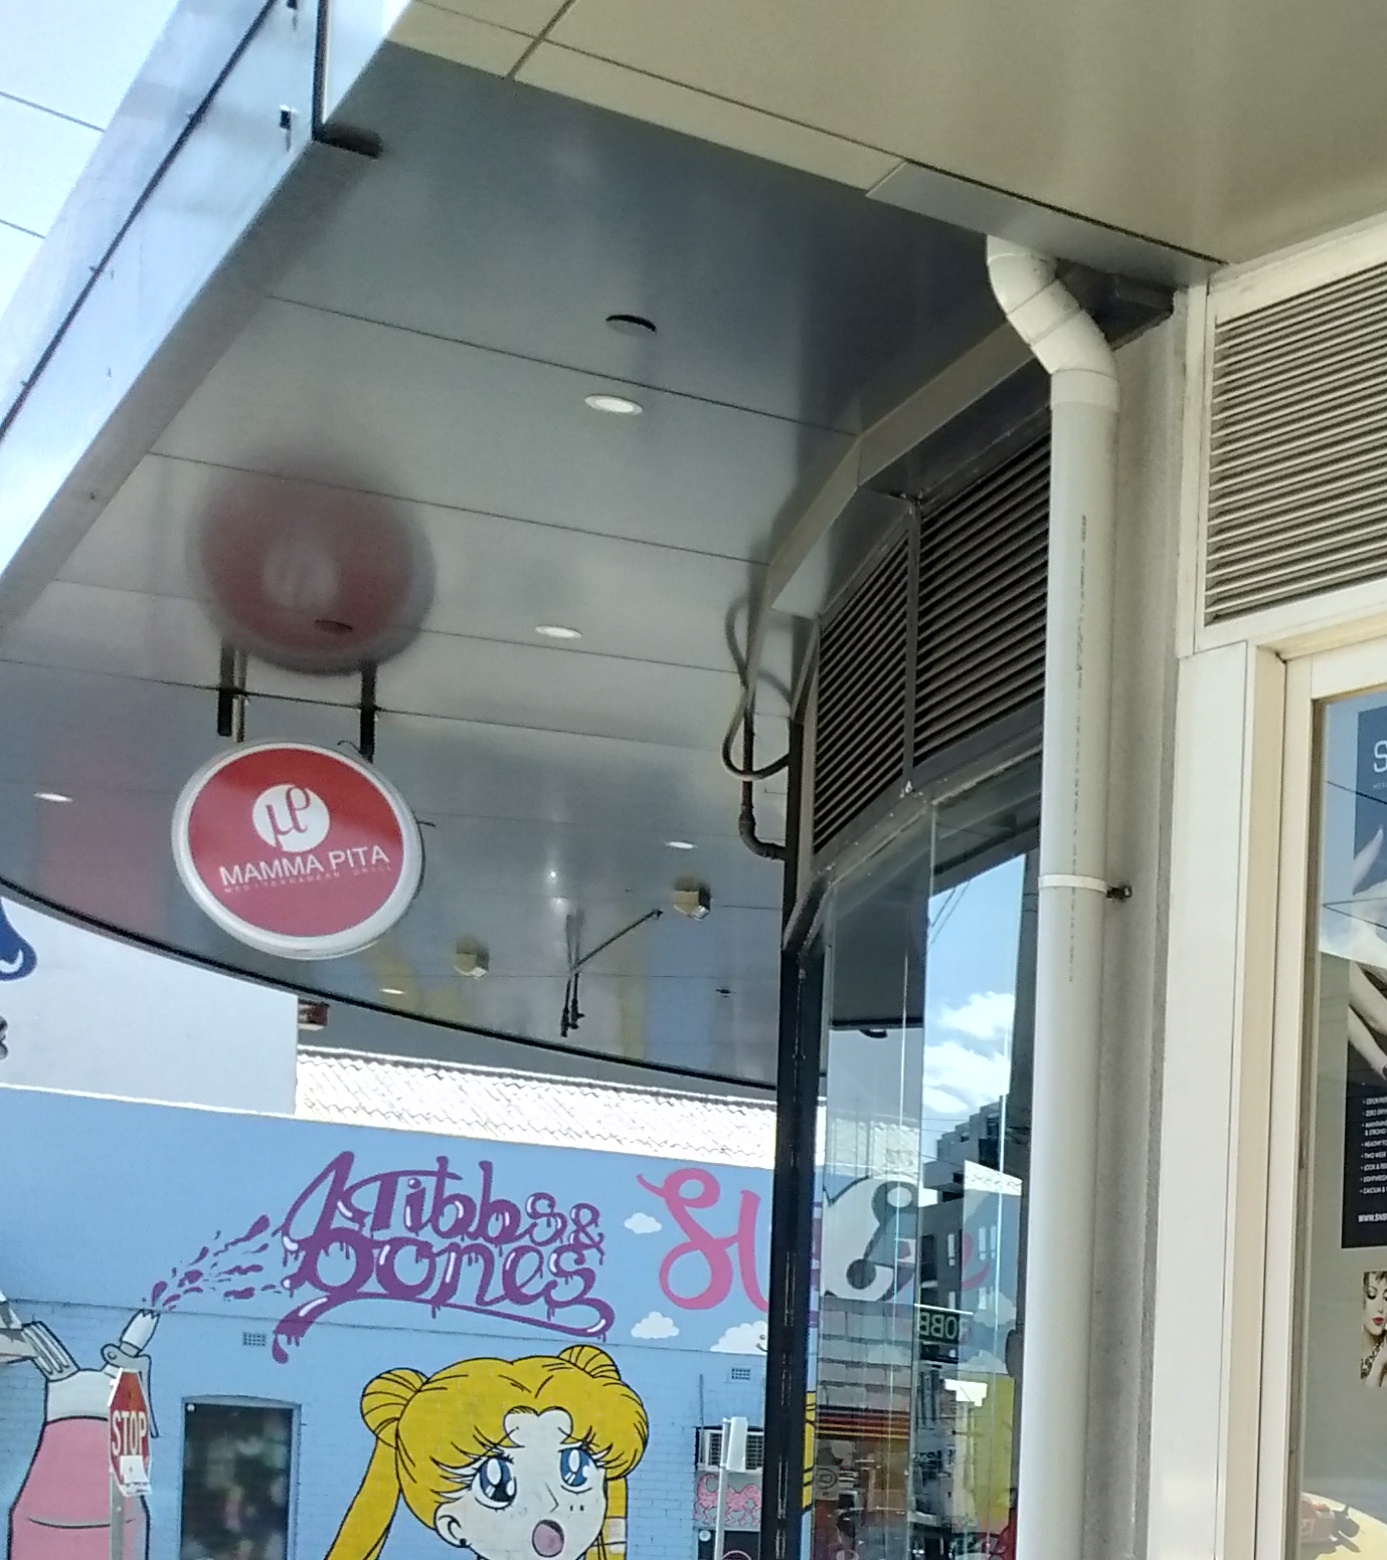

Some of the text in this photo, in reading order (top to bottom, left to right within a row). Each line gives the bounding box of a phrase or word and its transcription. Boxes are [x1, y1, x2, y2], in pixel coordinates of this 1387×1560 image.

[219, 845, 390, 887] MAMMA PITA
[111, 1410, 147, 1456] STOP
